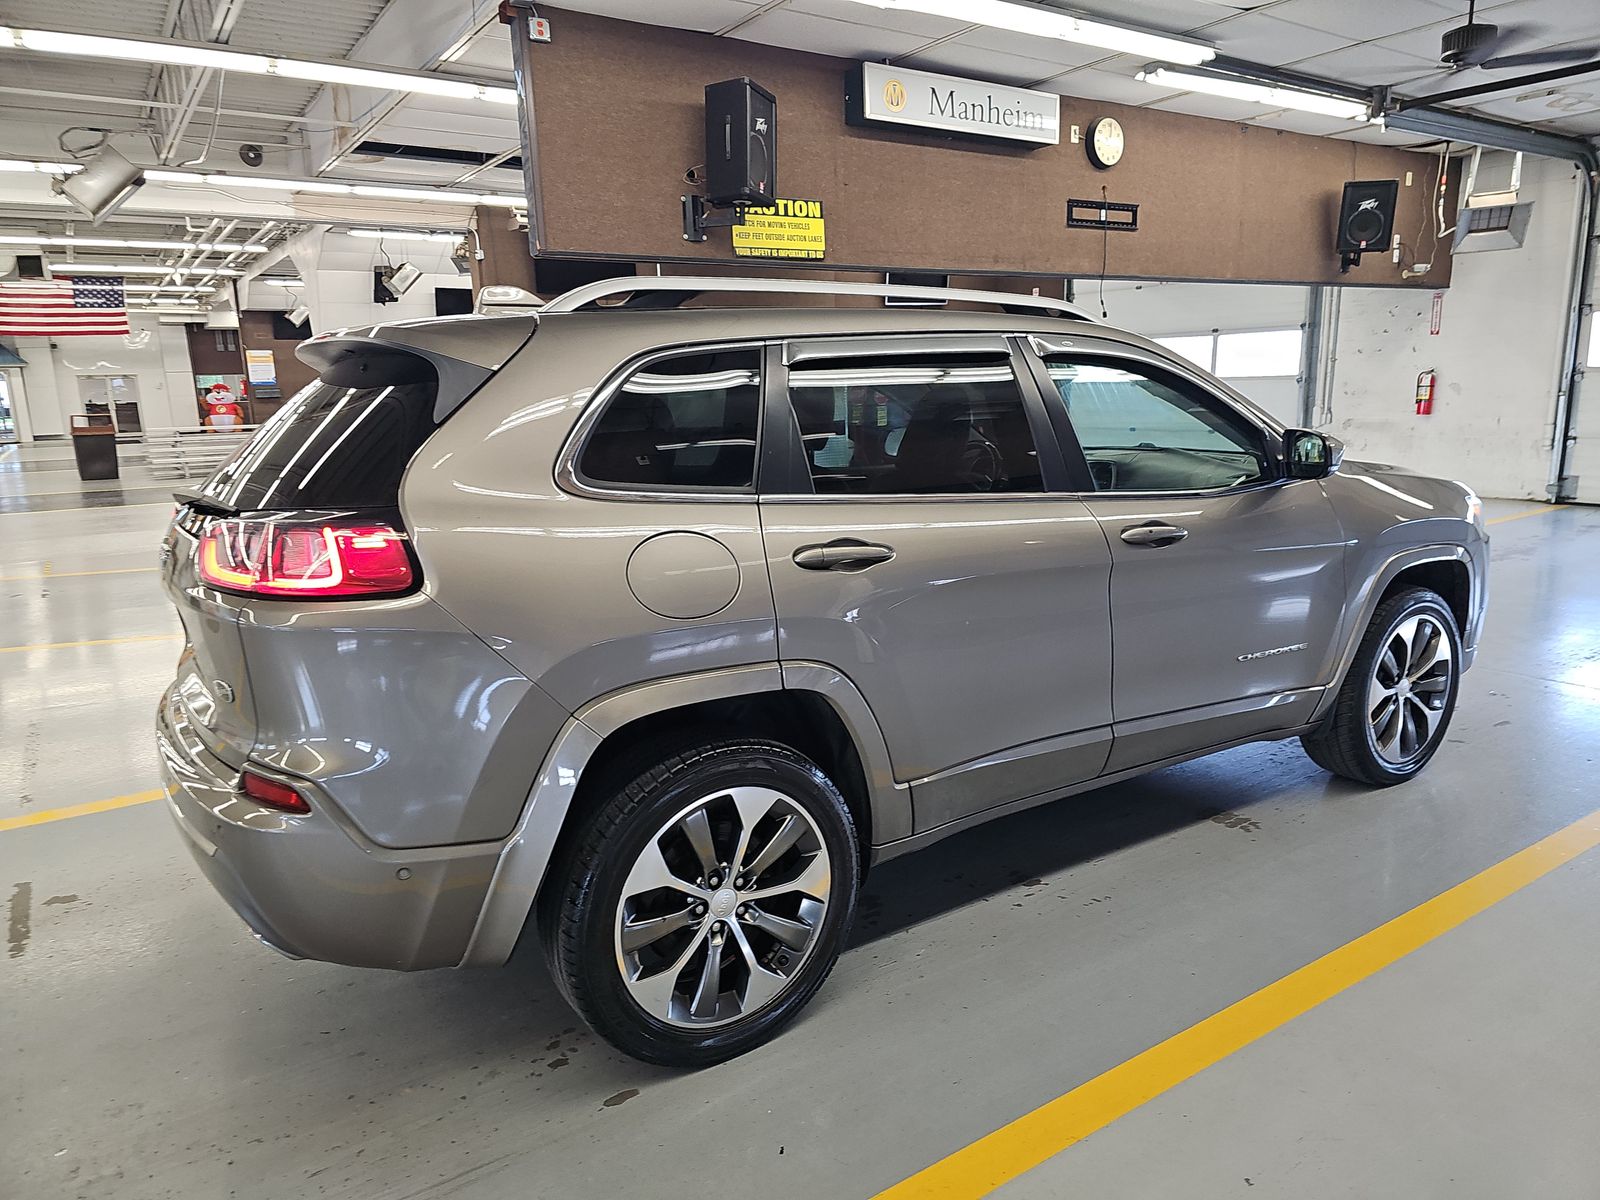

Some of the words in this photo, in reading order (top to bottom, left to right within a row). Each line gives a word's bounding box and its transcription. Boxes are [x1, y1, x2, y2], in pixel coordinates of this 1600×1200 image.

[928, 86, 1045, 131] Manheim
[736, 199, 821, 218] UTION
[756, 220, 766, 228] FOR
[767, 221, 786, 229] MOVING
[787, 222, 810, 231] VEHICLES
[752, 232, 764, 240] FEET
[765, 233, 785, 241] OUTSIDE
[808, 235, 823, 243] LANES
[751, 248, 771, 257] SAFETY
[771, 249, 778, 257] IS
[1237, 642, 1309, 661] CHEROKEE
